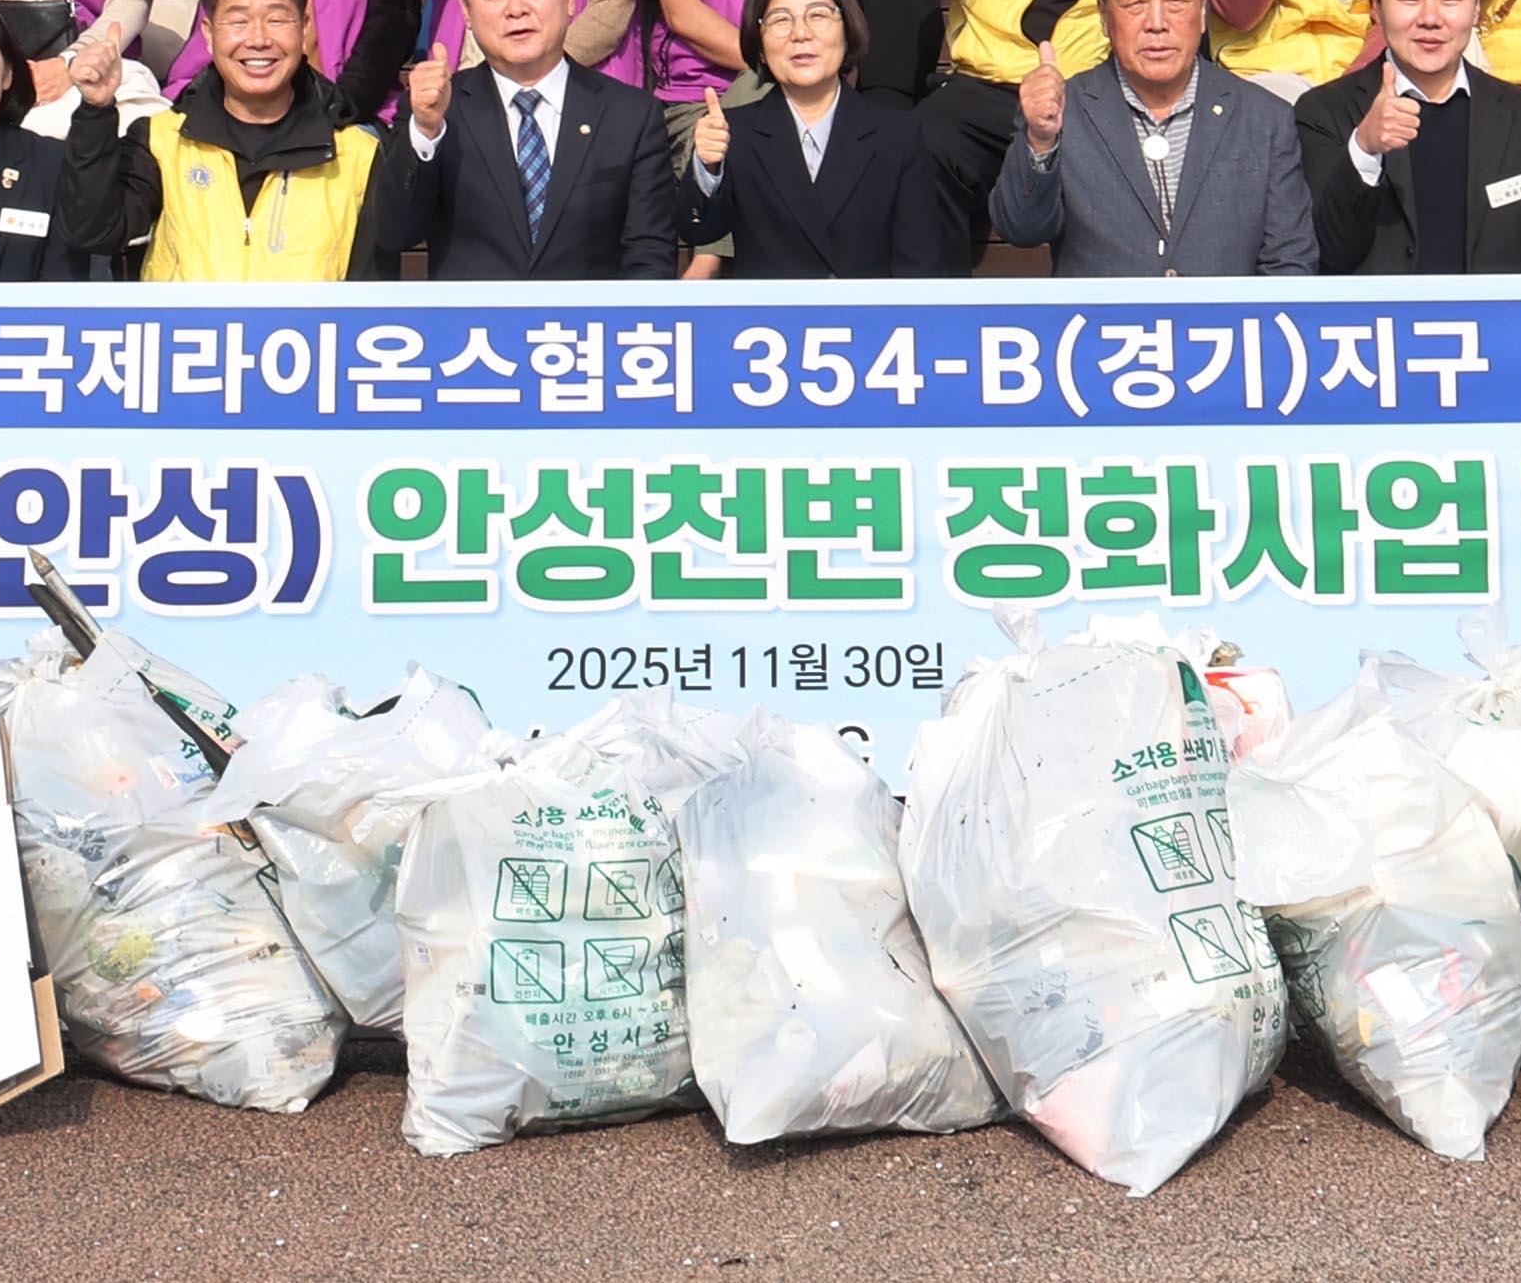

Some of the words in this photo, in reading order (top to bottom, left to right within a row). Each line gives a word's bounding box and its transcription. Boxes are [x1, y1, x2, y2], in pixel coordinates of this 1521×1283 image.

[731, 313, 1490, 418] 354-B(경기)지구
[366, 463, 904, 603] 안성천변
[944, 459, 1490, 599] 정화사업
[547, 644, 712, 691] 2025년
[732, 643, 829, 691] 11월
[844, 642, 944, 690] 30일
[1111, 740, 1179, 783] 소각용
[525, 1012, 577, 1026] 배출시간
[583, 1009, 607, 1022] 오후
[612, 1007, 632, 1018] 6시
[553, 1032, 575, 1055] 안
[589, 1030, 609, 1053] 성
[622, 1026, 640, 1047] 시
[652, 1020, 670, 1043] 장
